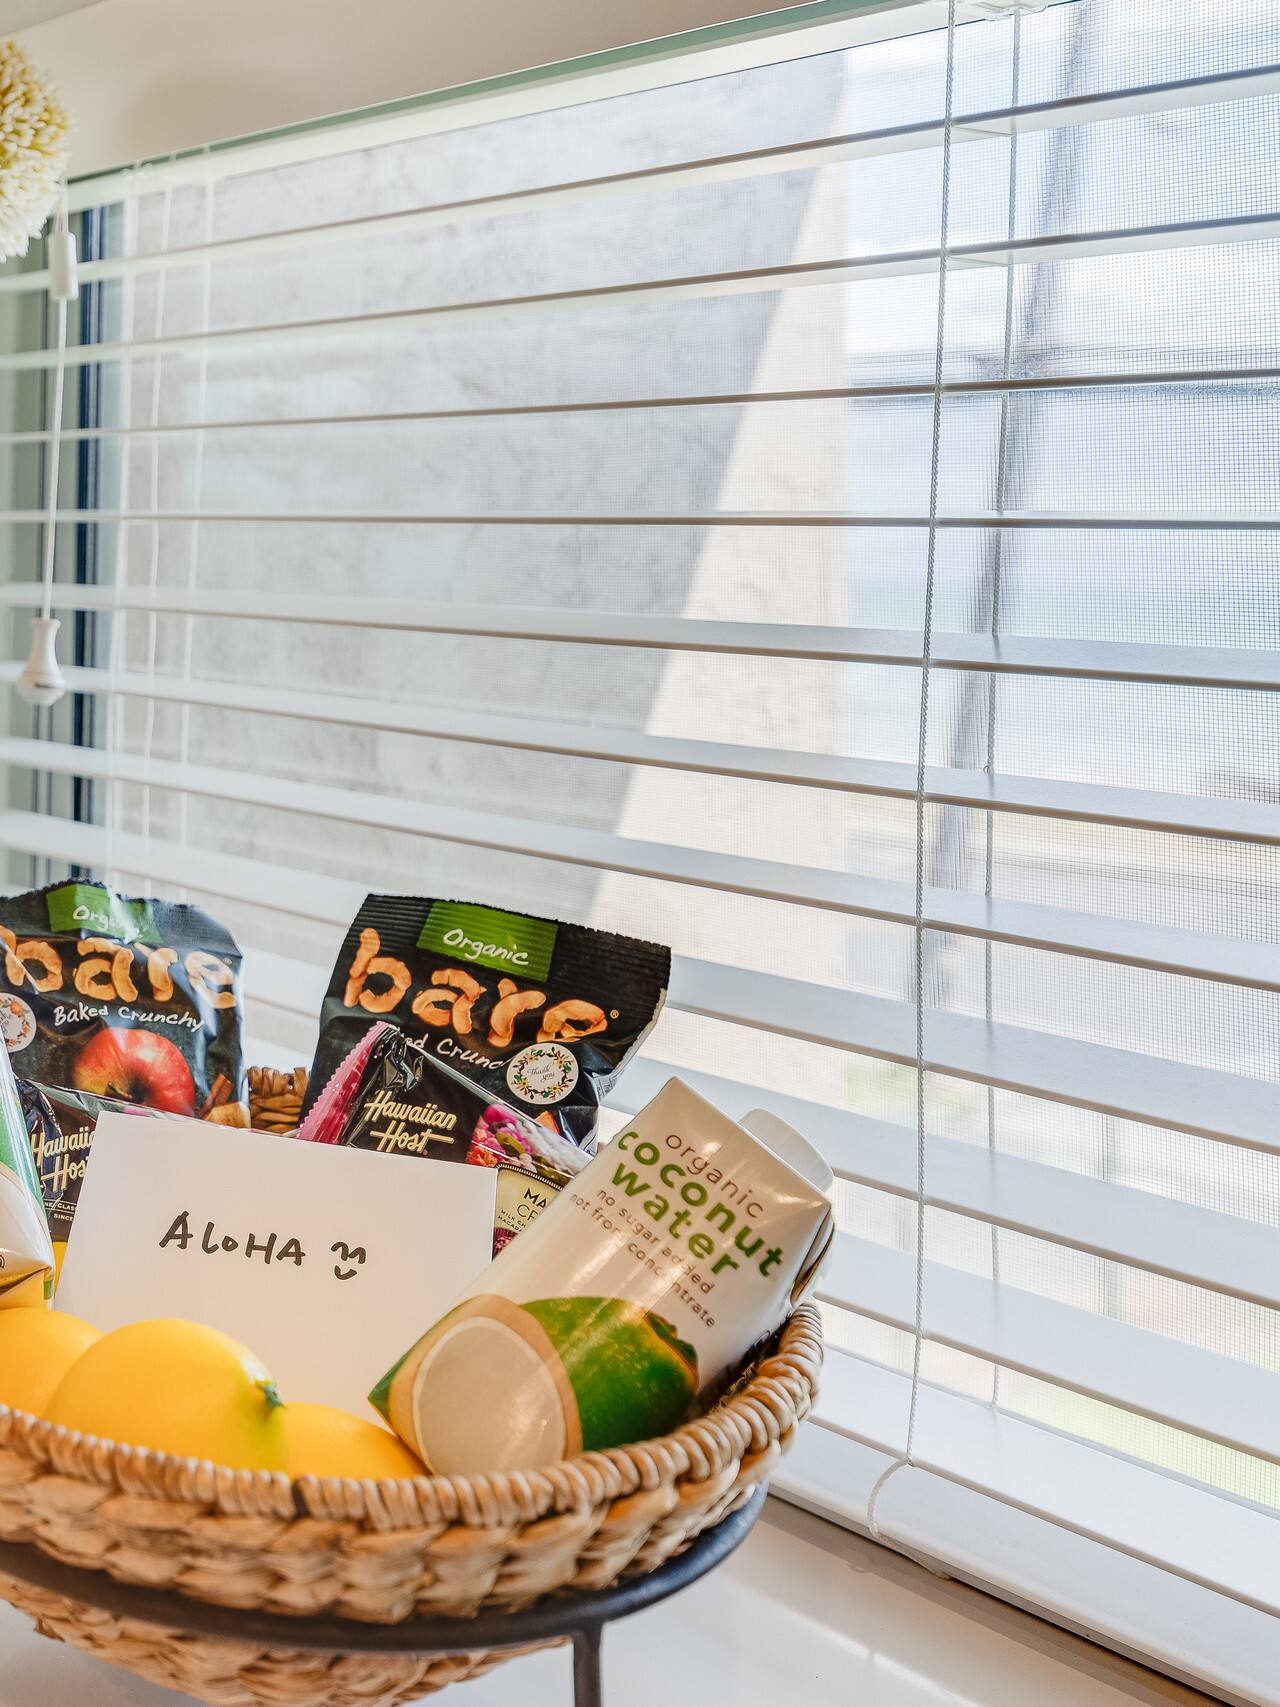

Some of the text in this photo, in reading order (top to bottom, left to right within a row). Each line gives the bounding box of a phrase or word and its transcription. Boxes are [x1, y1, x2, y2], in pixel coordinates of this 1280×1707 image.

[442, 928, 529, 966] Organic
[344, 927, 609, 1048] bare
[54, 1002, 204, 1033] Baked Crunchy
[436, 1038, 513, 1070] Crunc
[527, 1062, 554, 1076] Thank
[540, 1072, 555, 1083] you
[363, 1090, 457, 1131] Hawaiian
[369, 1119, 455, 1153] Host
[41, 1153, 89, 1193] Hos
[665, 1134, 764, 1219] organic
[53, 1213, 74, 1222] SINCE
[57, 1203, 77, 1211] CLAS
[501, 1209, 515, 1221] MILK
[597, 1190, 616, 1206] no
[618, 1207, 660, 1244] sugar
[611, 1162, 740, 1276] water
[618, 1131, 784, 1278] coconut
[570, 1193, 591, 1211] not
[627, 1242, 716, 1328] concntrate
